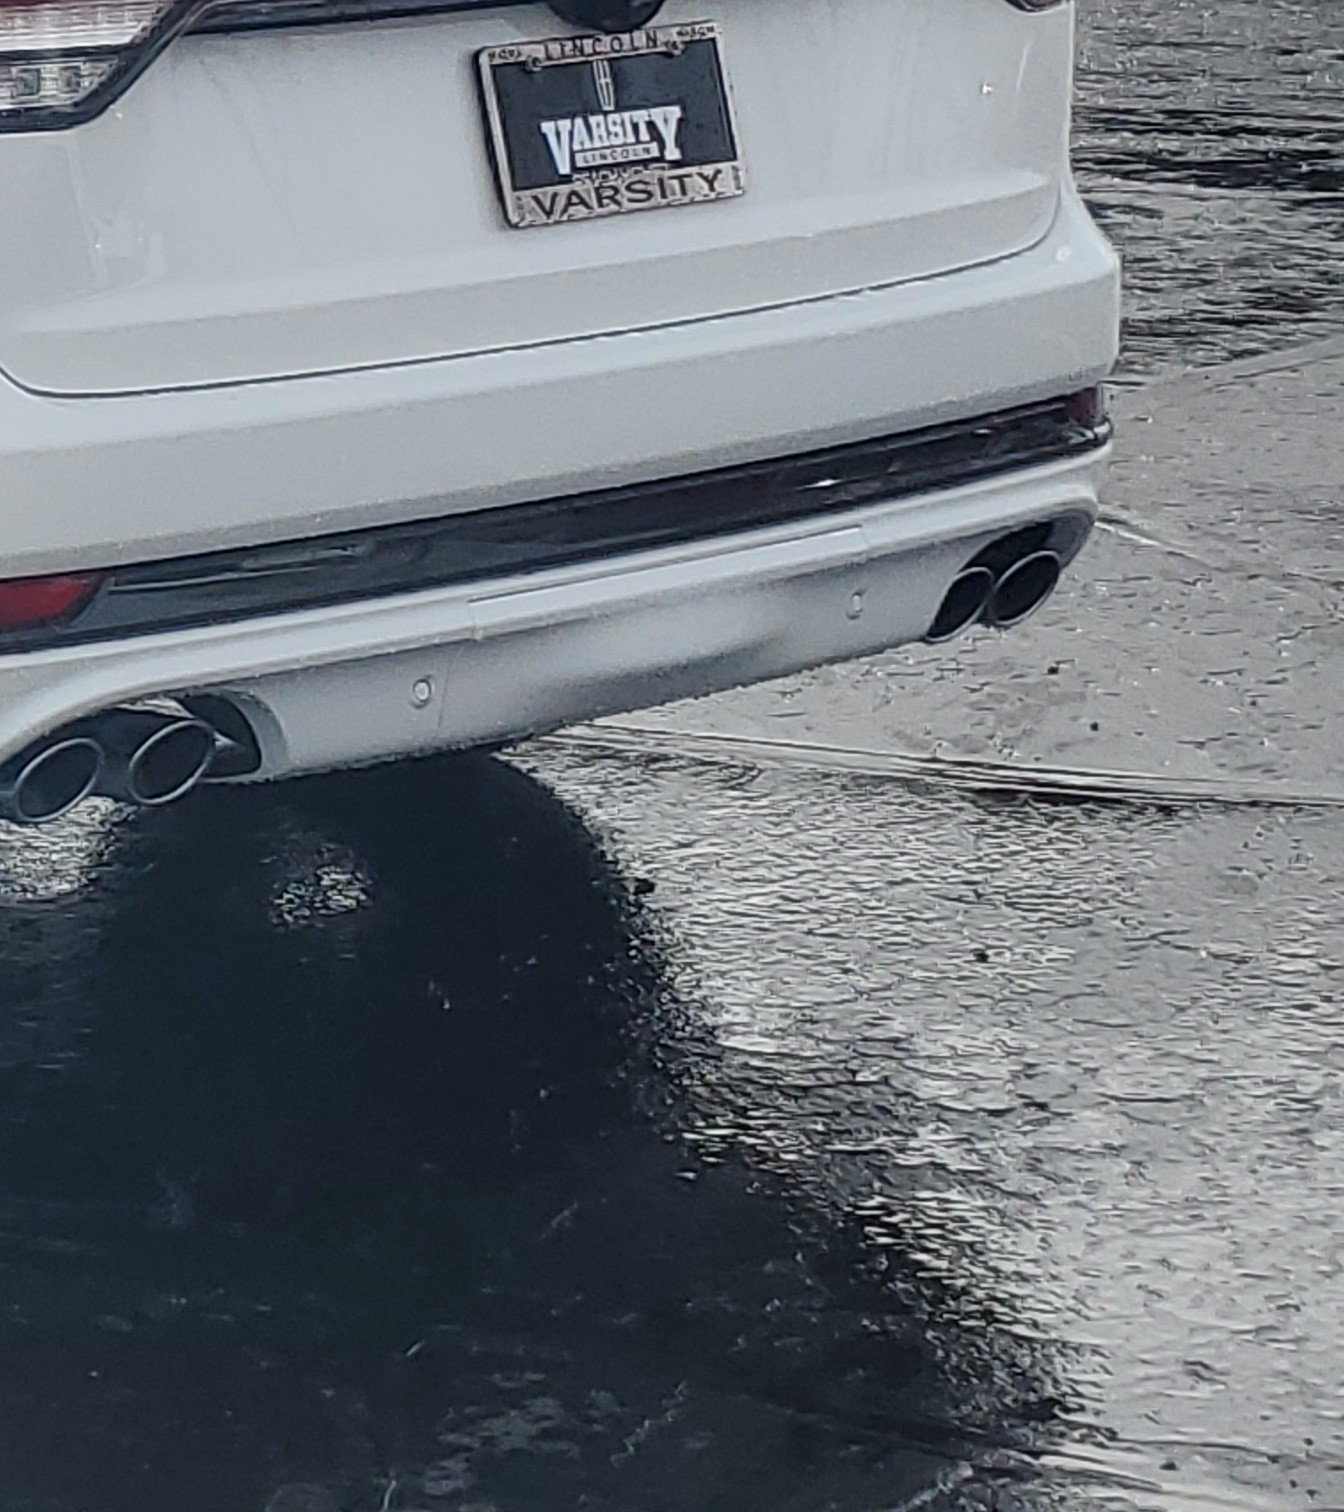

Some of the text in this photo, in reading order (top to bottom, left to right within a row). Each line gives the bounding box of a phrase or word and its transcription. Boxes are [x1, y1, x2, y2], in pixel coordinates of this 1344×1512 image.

[543, 29, 658, 61] LINCOLN
[541, 105, 682, 175] VARSITY
[582, 146, 652, 165] LINCOLN
[531, 171, 723, 220] VARSITY
